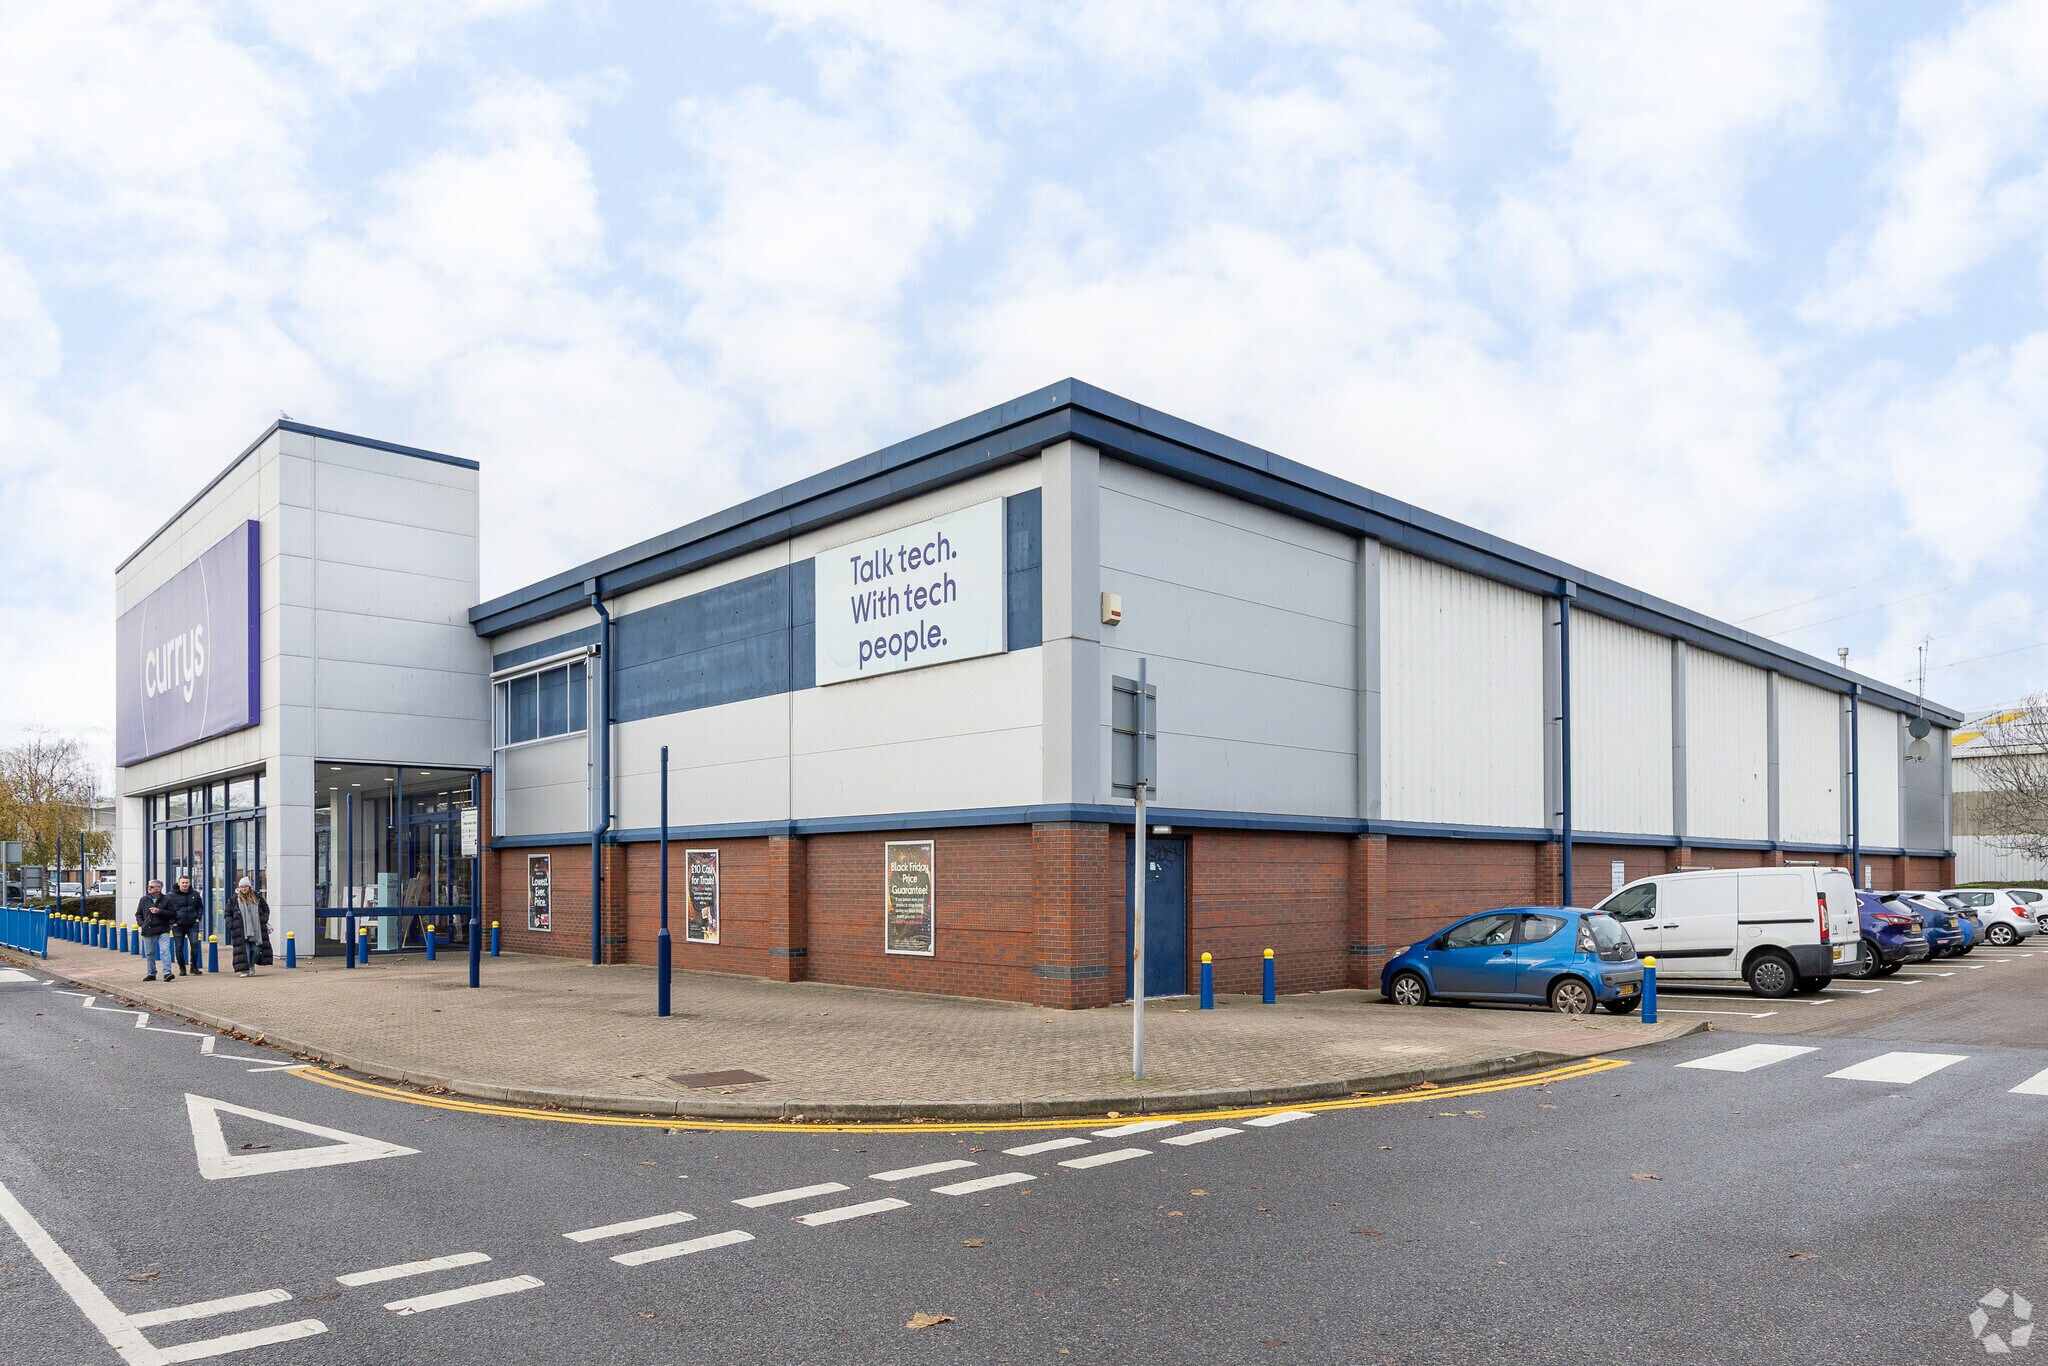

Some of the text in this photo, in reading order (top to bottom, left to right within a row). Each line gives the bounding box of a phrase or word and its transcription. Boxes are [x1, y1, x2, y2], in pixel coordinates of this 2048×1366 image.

[850, 531, 957, 585] Talk tech.
[850, 572, 957, 624] With tech
[859, 619, 948, 670] people.
[145, 624, 205, 703] currys
[691, 875, 715, 885] for Trash!
[890, 862, 929, 874] Black Friday
[902, 874, 918, 884] Price
[891, 884, 929, 895] Guarantee!
